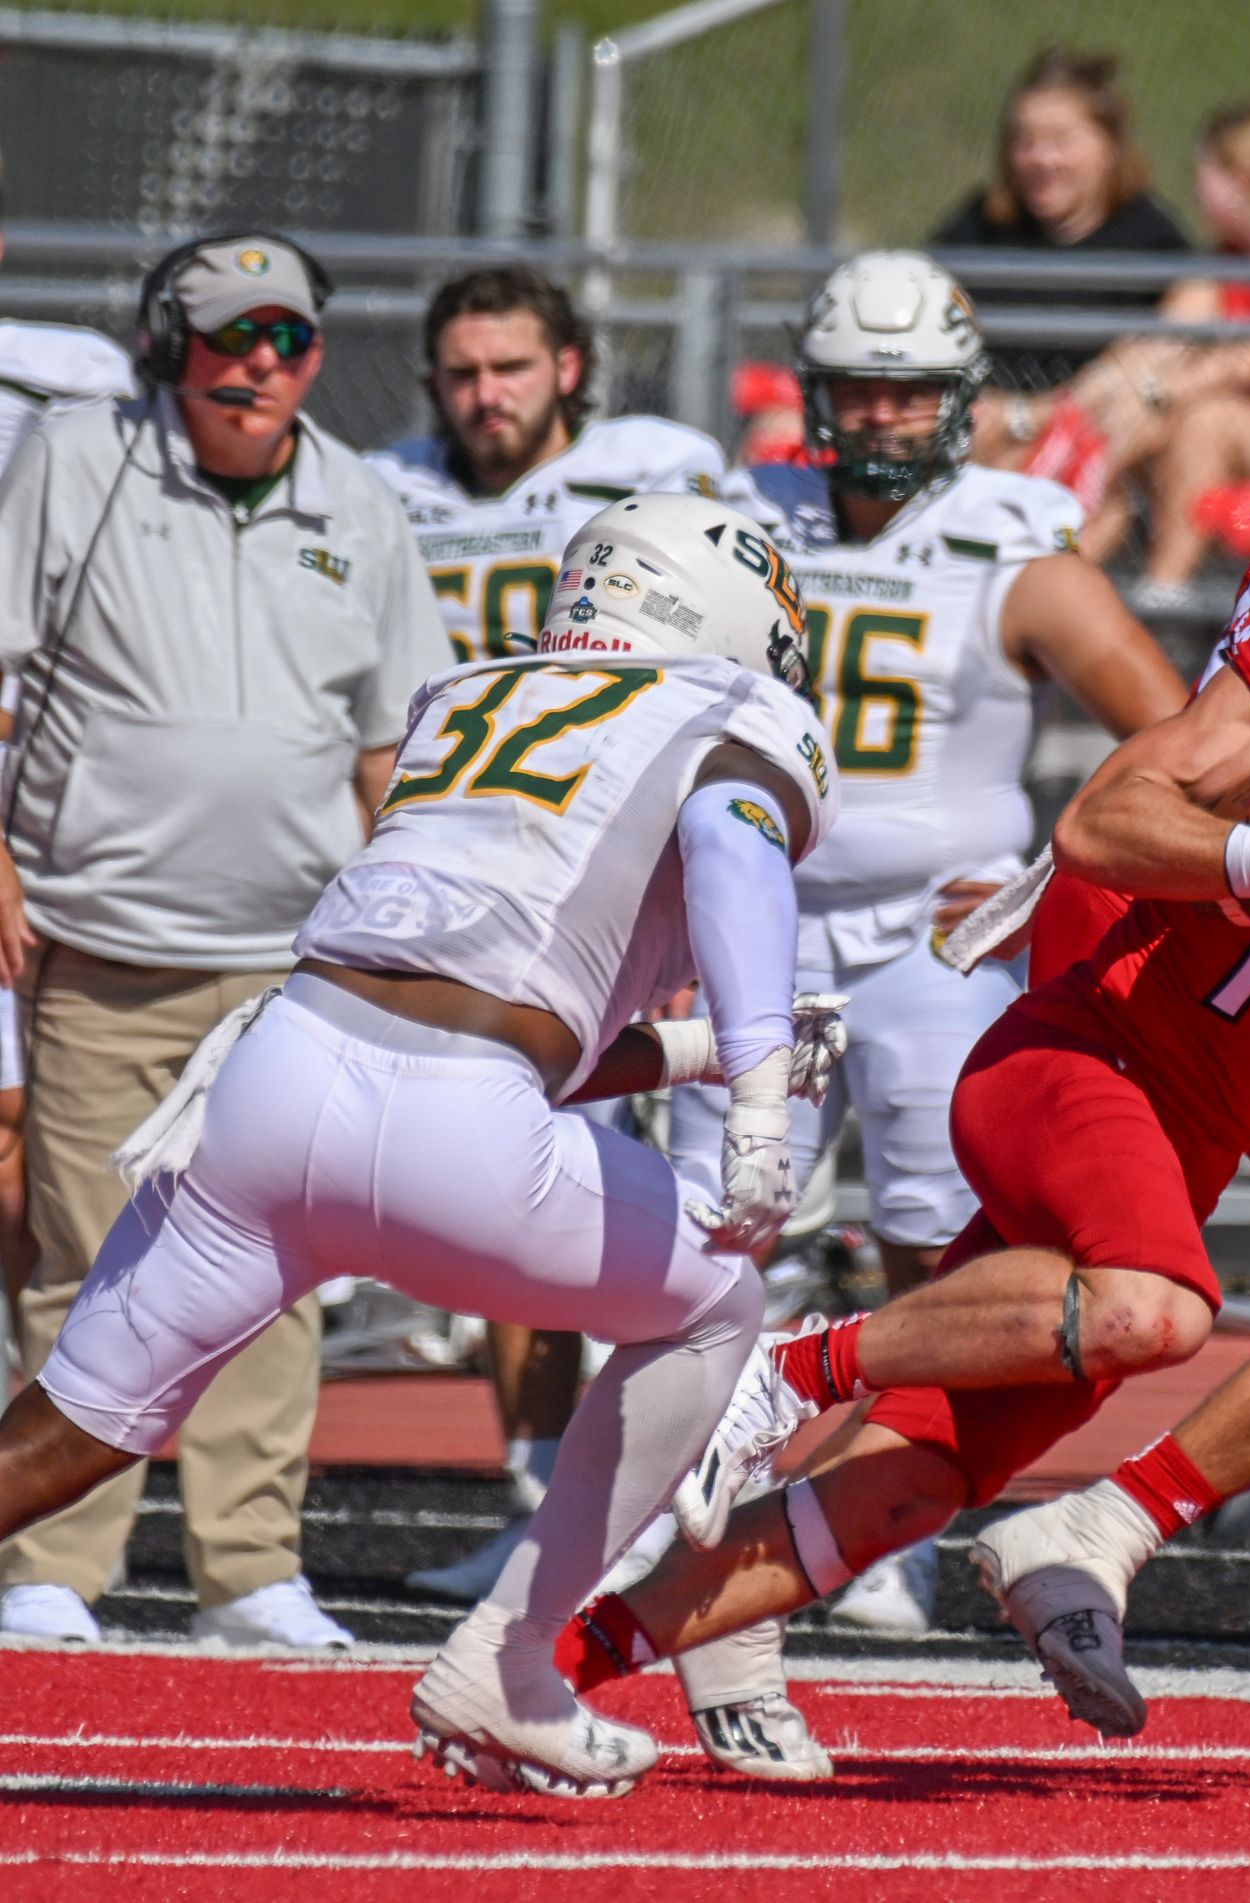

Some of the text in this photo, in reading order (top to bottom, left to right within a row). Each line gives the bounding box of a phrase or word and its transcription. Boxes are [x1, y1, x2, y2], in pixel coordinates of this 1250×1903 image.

[590, 544, 613, 567] 32
[607, 578, 634, 592] SLC
[540, 629, 632, 653] Riddell
[381, 663, 663, 816] 32
